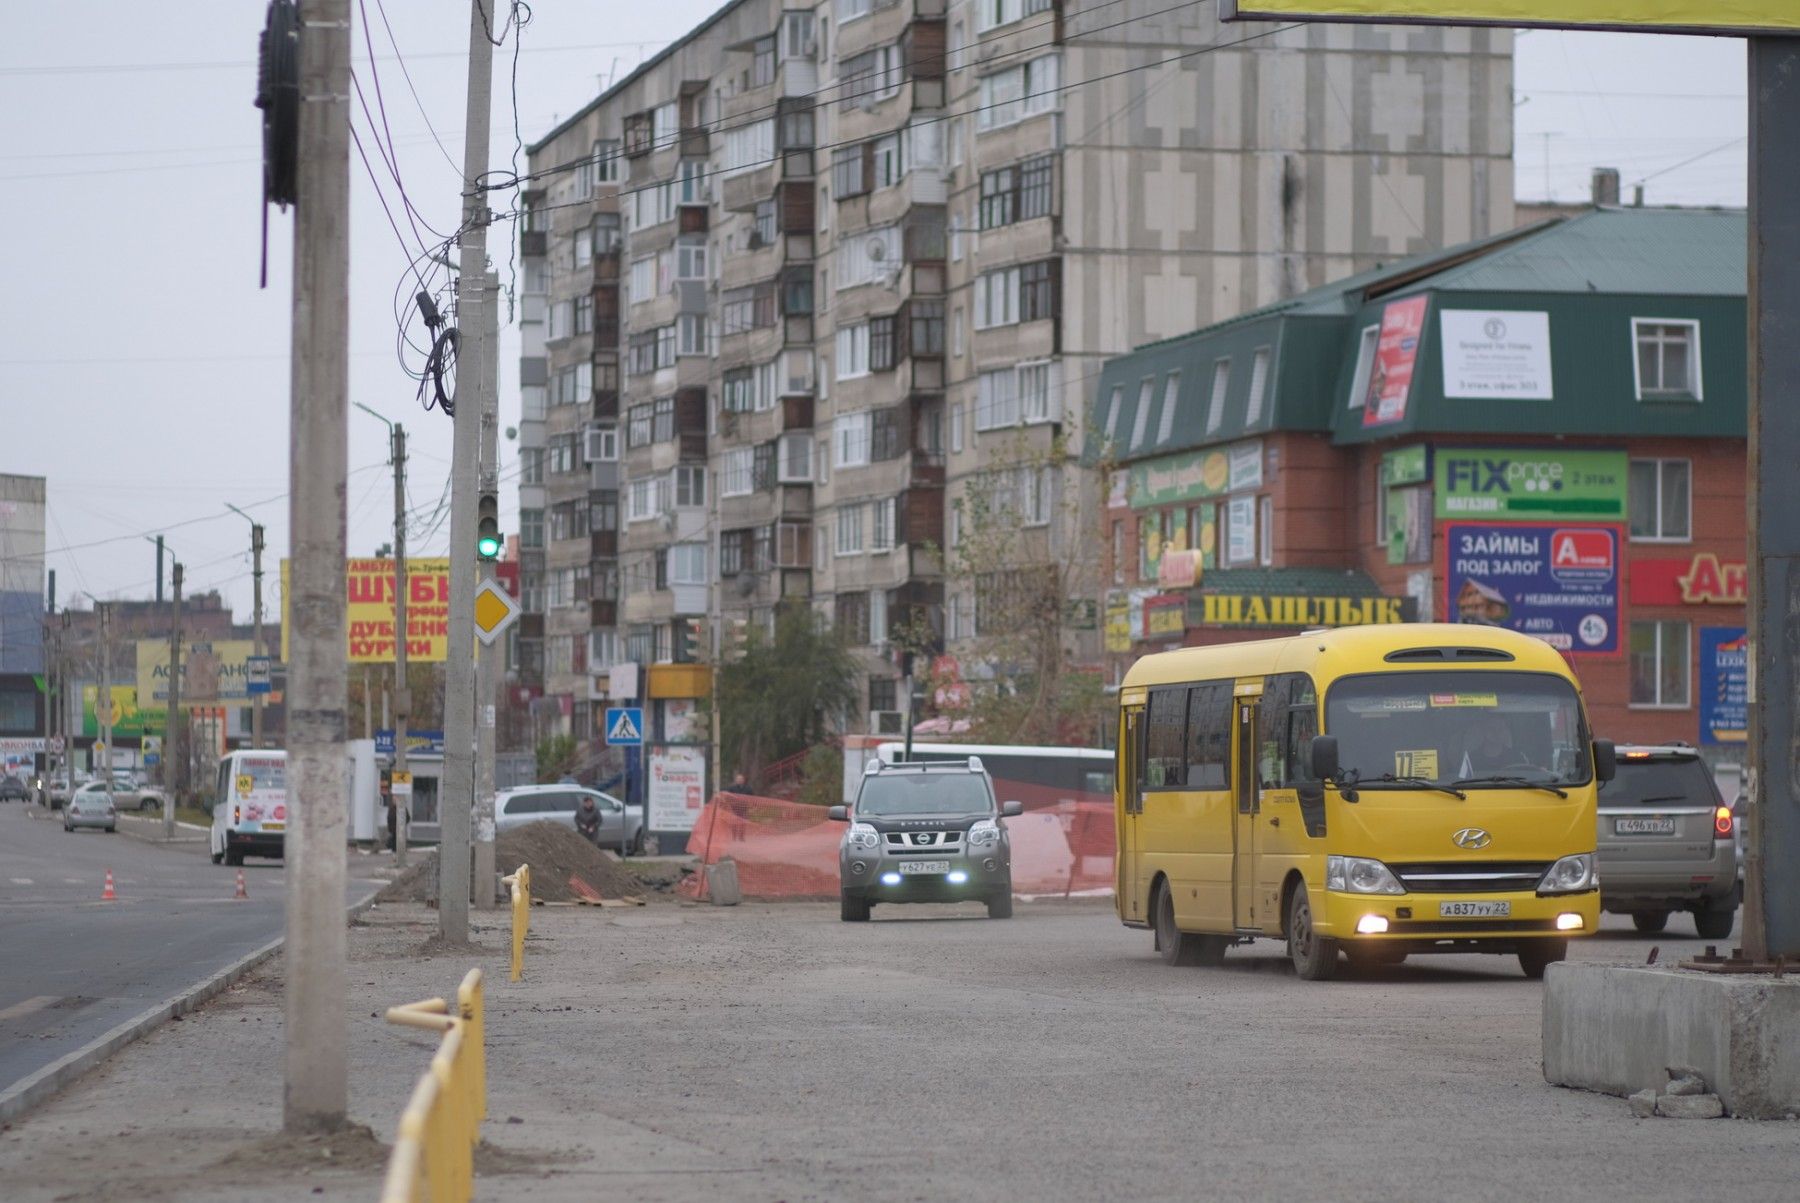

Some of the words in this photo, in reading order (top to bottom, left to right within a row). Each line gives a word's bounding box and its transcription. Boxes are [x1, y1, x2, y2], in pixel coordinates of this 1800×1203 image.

[1460, 532, 1540, 555] ЗАЙМЫ
[1456, 560, 1490, 577] ПОД
[1492, 560, 1542, 576] ЗАЛОГ
[1203, 594, 1403, 626] ШАШЛЫК
